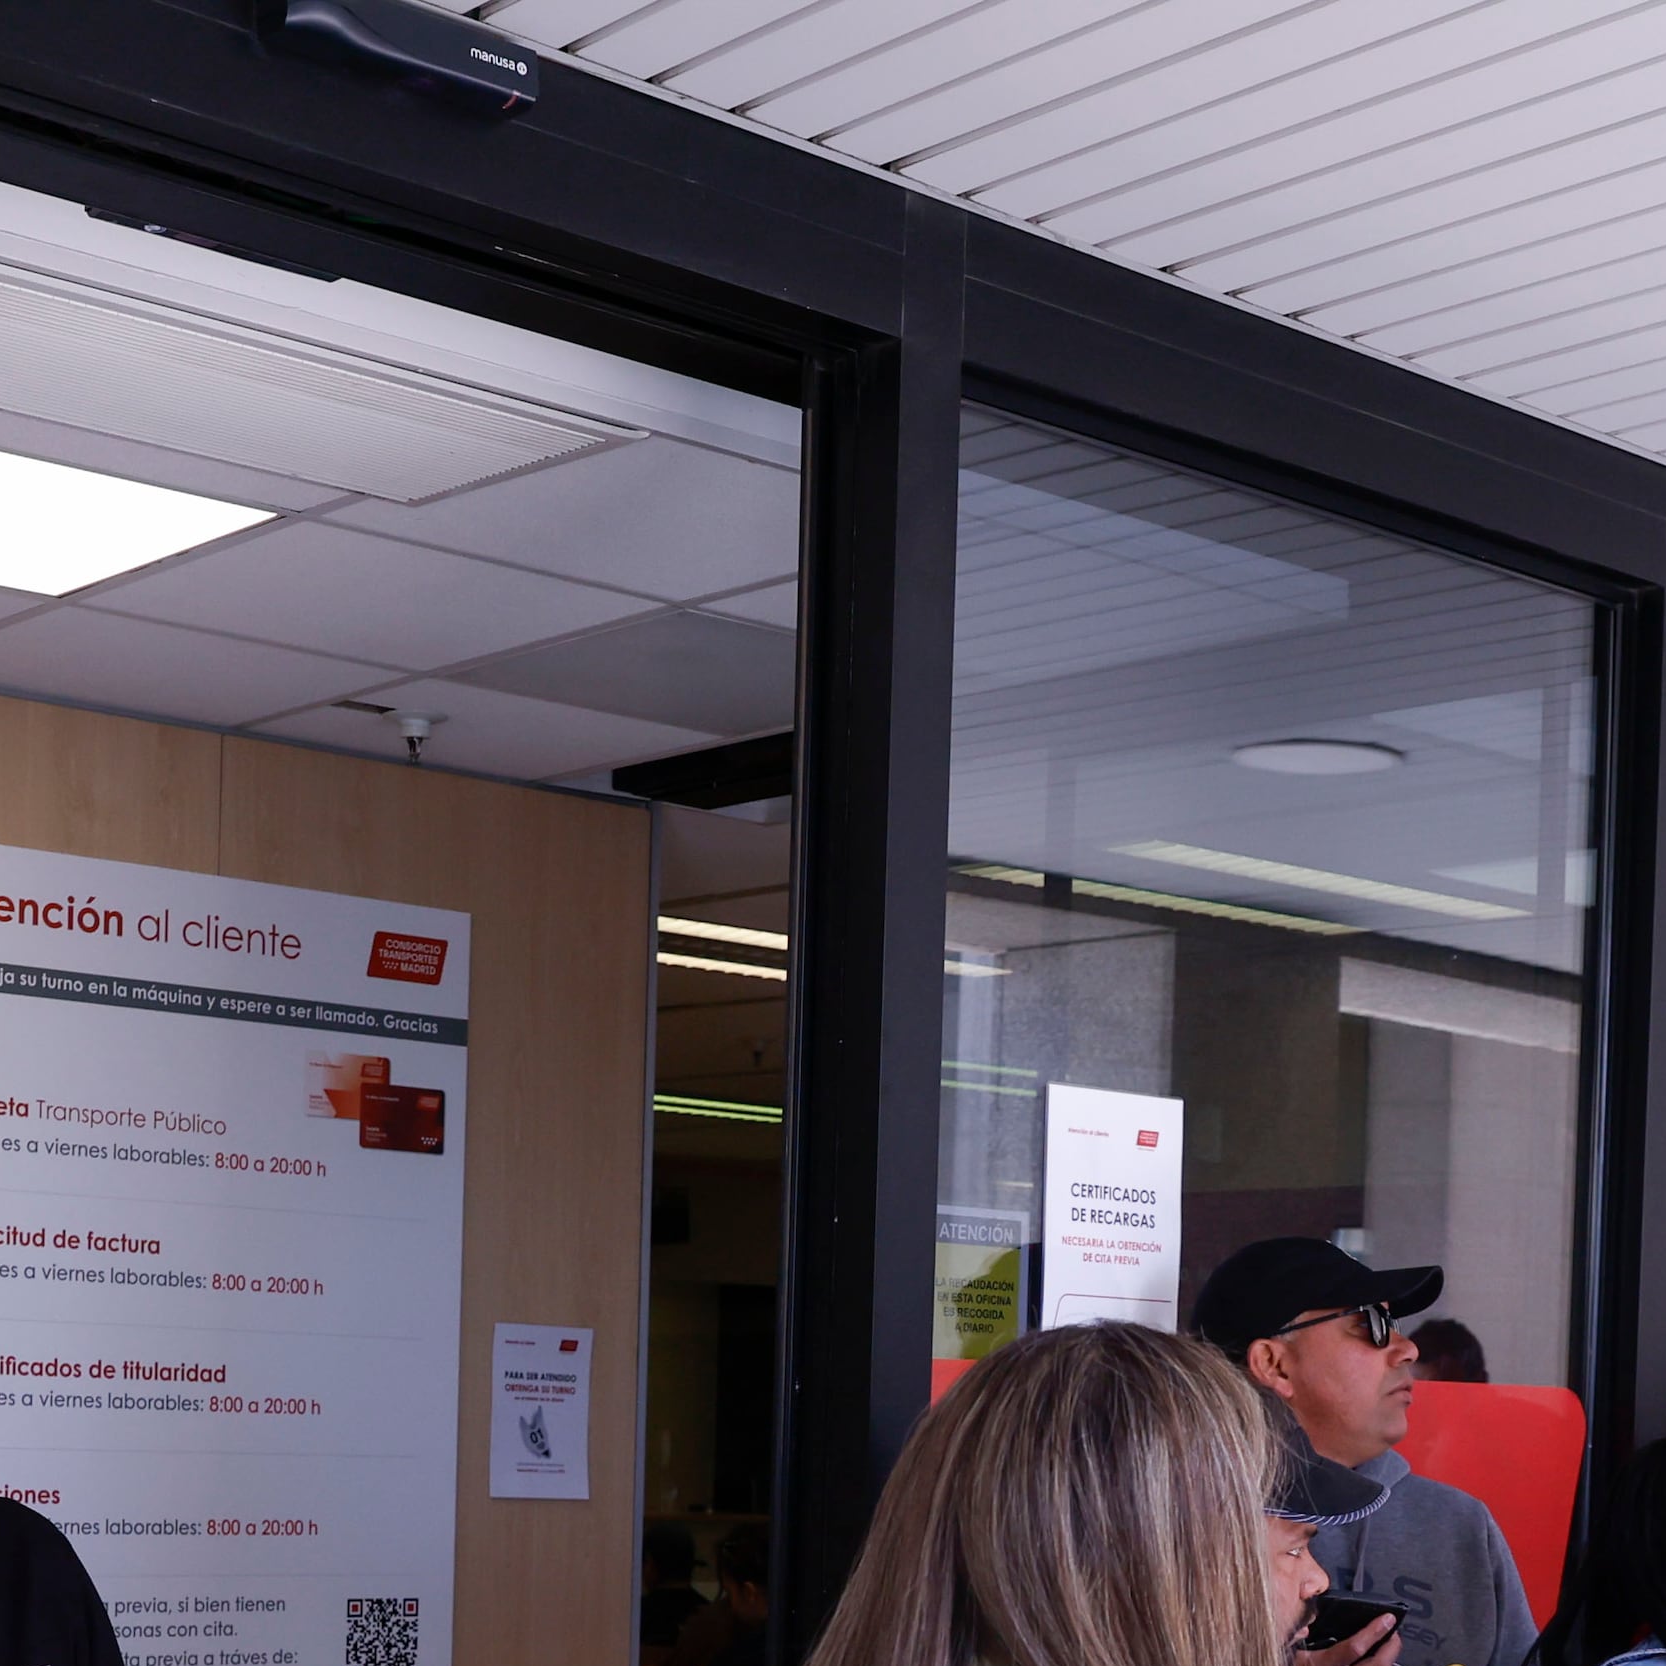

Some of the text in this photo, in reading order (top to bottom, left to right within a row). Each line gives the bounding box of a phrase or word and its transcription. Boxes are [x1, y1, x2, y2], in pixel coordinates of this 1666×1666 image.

[470, 47, 516, 72] manusa
[137, 909, 169, 943] al
[182, 914, 302, 960] cliente
[385, 938, 441, 955] CONSORCIO
[378, 948, 439, 966] TRANSPORTES
[400, 962, 437, 976] MADRID
[20, 973, 37, 987] su
[41, 973, 84, 992] turno
[88, 982, 109, 996] en
[112, 981, 128, 998] la
[132, 985, 202, 1007] máquina
[206, 996, 216, 1011] y
[220, 997, 271, 1016] espere
[276, 1003, 285, 1016] a
[290, 1005, 311, 1019] ser
[315, 1006, 379, 1028] llamado.
[383, 1014, 439, 1035] Gracias
[35, 1099, 146, 1128] Transporte
[153, 1110, 227, 1136] Público
[27, 1140, 38, 1153] a
[44, 1138, 108, 1160] viernes
[113, 1143, 210, 1168] laborables:
[214, 1152, 249, 1171] 8:00
[253, 1159, 264, 1172] a
[269, 1156, 312, 1177] 20:00
[317, 1161, 326, 1177] h
[1070, 1182, 1157, 1205] CERTIFICADOS
[1071, 1207, 1156, 1229] DE RECARGAS
[939, 1220, 1014, 1244] ATENCIÓN
[53, 1229, 80, 1249] de
[87, 1231, 161, 1255] factura
[1061, 1235, 1162, 1253] NECESARIA LA OBTENCIÓN
[1083, 1252, 1140, 1266] DE CITA PREVIA
[23, 1266, 35, 1279] a
[41, 1264, 105, 1284] viernes
[110, 1267, 207, 1289] laborables:
[211, 1273, 246, 1291] 8:00
[251, 1279, 261, 1292] a
[266, 1276, 309, 1295] 20:00
[314, 1279, 323, 1295] h
[948, 1277, 1014, 1292] RECAUDACIÓN
[951, 1292, 973, 1303] ESTA
[975, 1294, 1012, 1306] OFICINA
[957, 1307, 1005, 1320] RECOGIDA
[963, 1323, 994, 1334] DIARIO
[88, 1360, 116, 1379] de
[122, 1361, 226, 1383] titularidad
[504, 1370, 577, 1383] PARA SER ATENDIDO
[505, 1383, 576, 1396] OBTENGA SU TURNO
[21, 1394, 33, 1407] a
[39, 1390, 102, 1409] viernes
[107, 1392, 204, 1412] laborables:
[209, 1396, 243, 1413] 8:00
[248, 1401, 259, 1414] a
[264, 1397, 307, 1415] 20:00
[311, 1399, 321, 1415] h
[54, 1518, 318, 1536] ernes laborables: 8:00 a 20:00 h
[114, 1597, 172, 1617] previa,
[177, 1597, 189, 1613] si
[194, 1596, 230, 1613] bien
[236, 1597, 286, 1612] tienen
[114, 1621, 238, 1638] sonas con cita.
[123, 1652, 140, 1666] ta
[203, 1653, 214, 1666] a
[219, 1649, 268, 1665] tráves
[272, 1648, 298, 1664] de:
